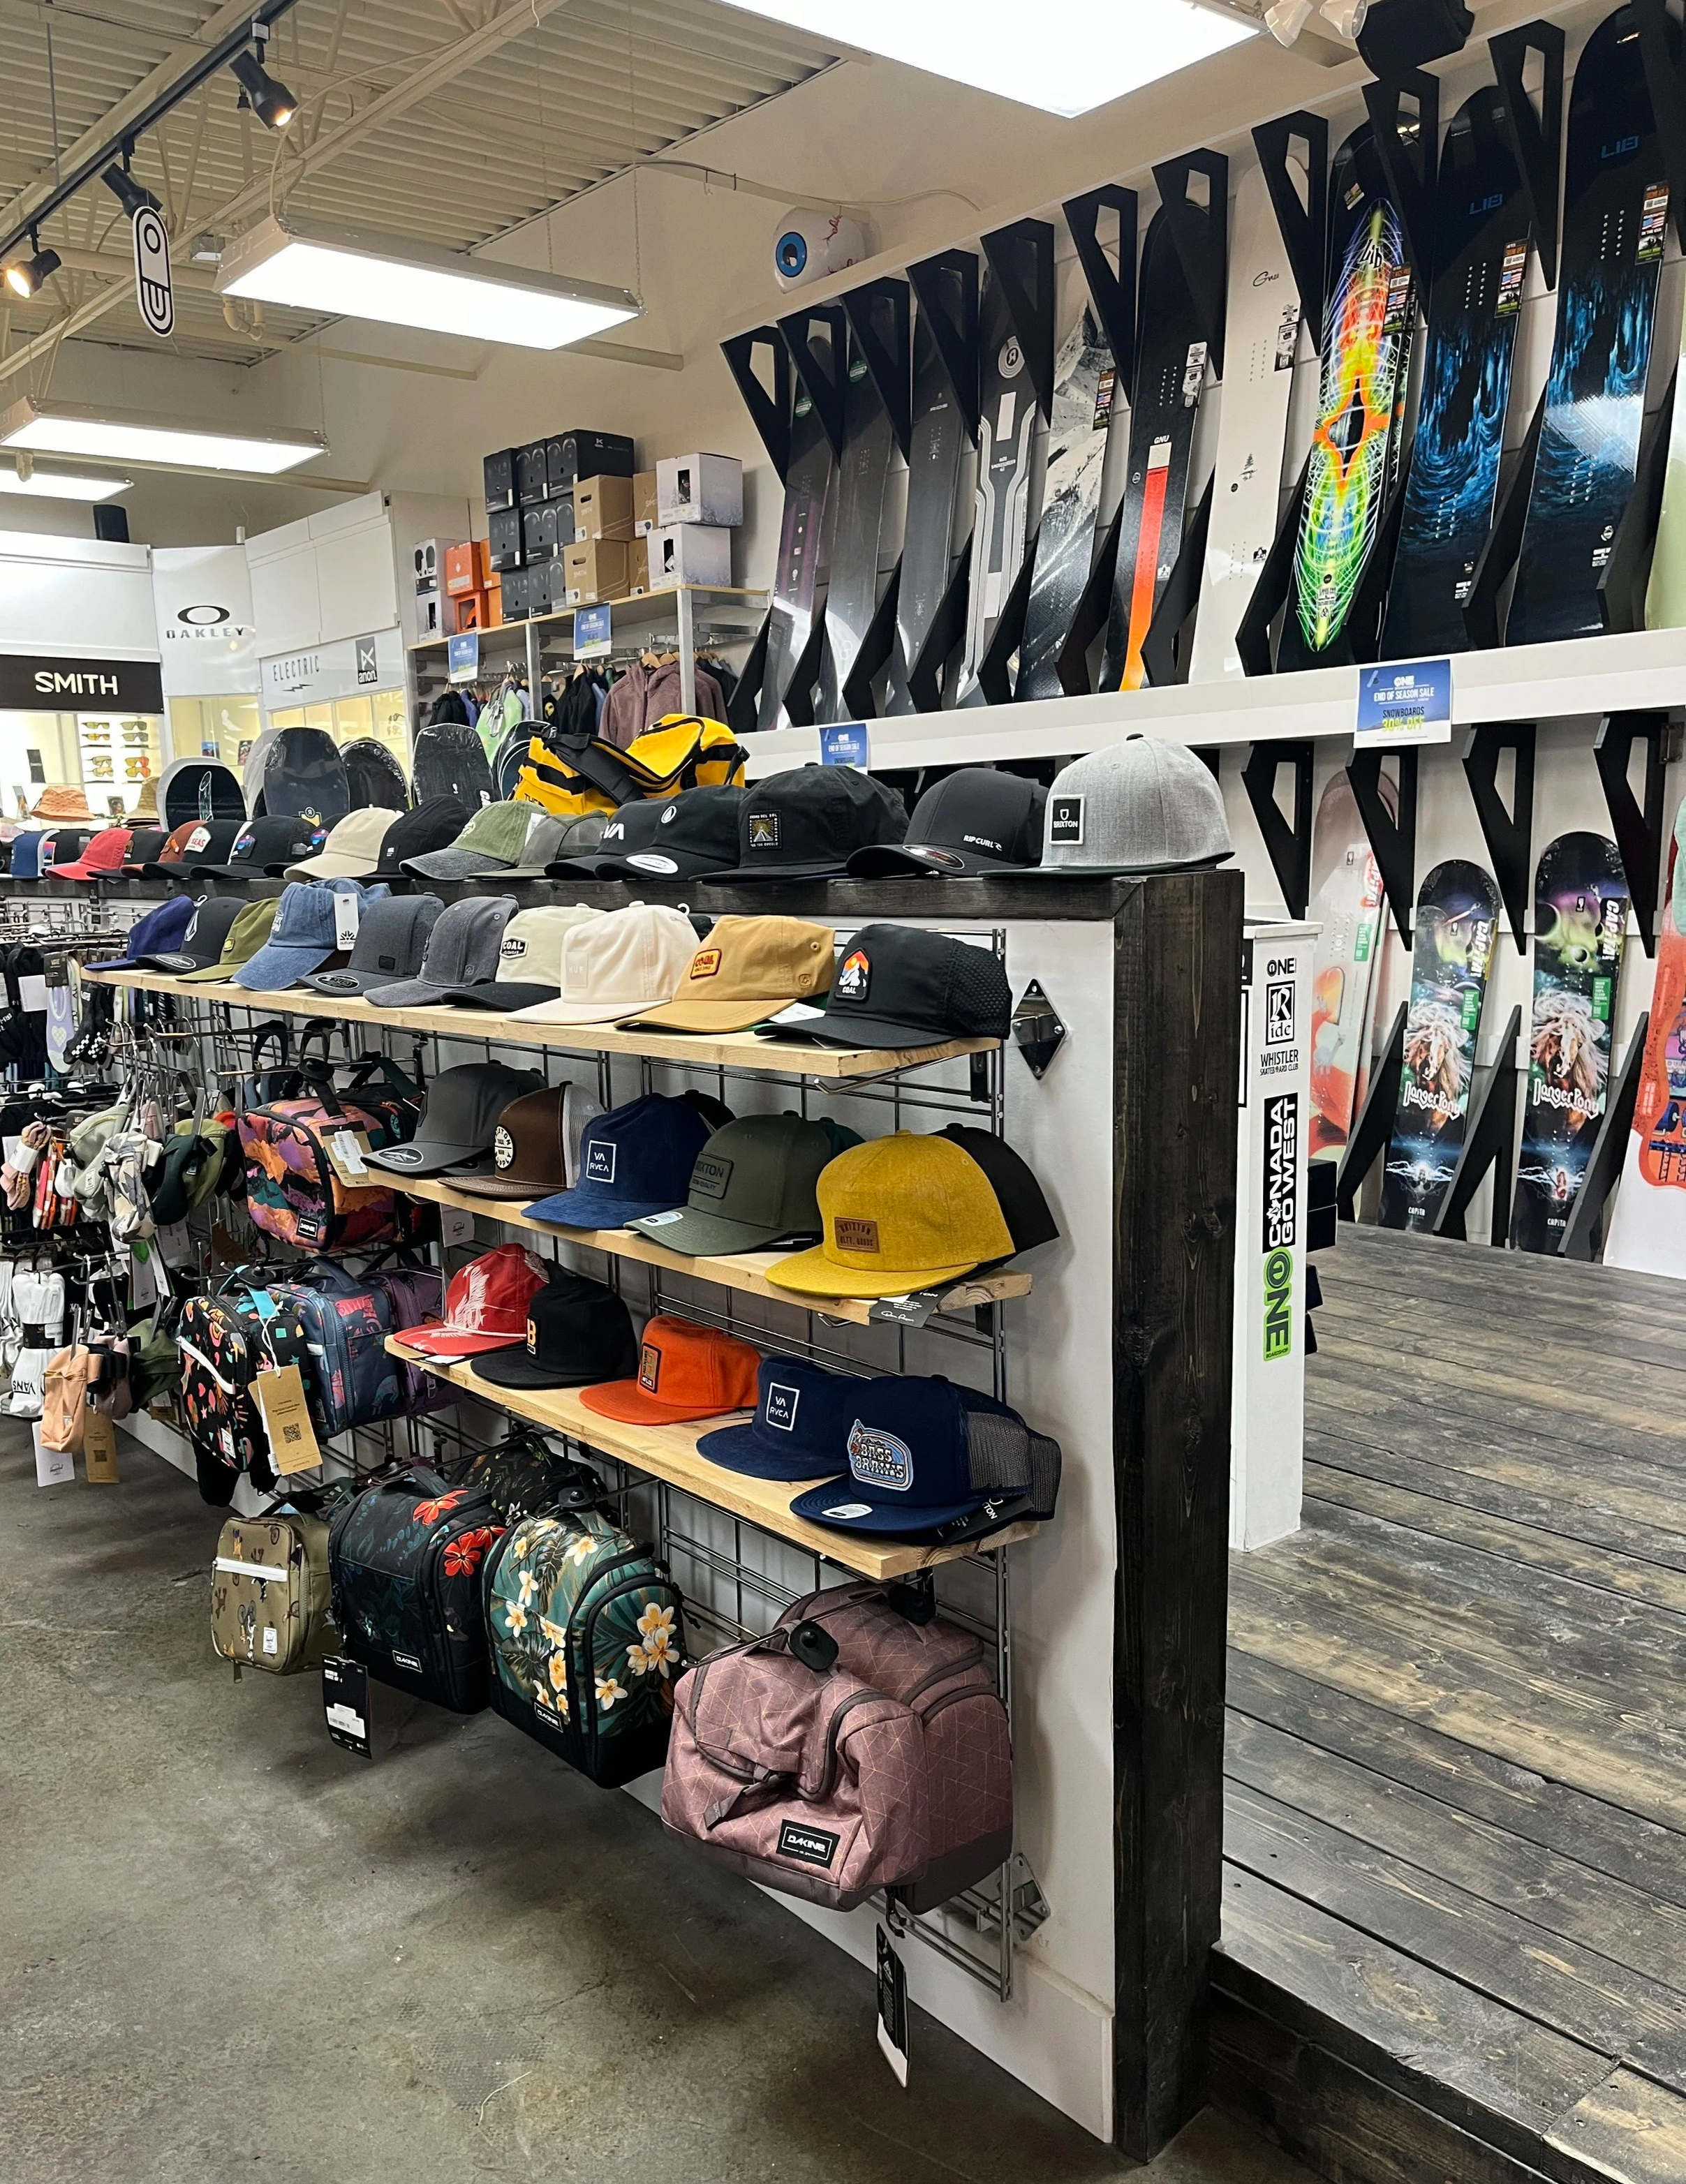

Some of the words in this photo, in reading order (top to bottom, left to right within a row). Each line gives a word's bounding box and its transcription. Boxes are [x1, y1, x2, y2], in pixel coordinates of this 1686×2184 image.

[1601, 135, 1639, 159] LIB
[1469, 193, 1503, 215] LIB
[1153, 435, 1170, 445] GNU
[165, 627, 244, 639] OAKLEY
[273, 655, 320, 682] ELECTRIC
[34, 671, 119, 696] SMITH
[1373, 691, 1386, 702] END
[1386, 690, 1395, 701] OF
[1395, 688, 1419, 700] SEASON
[1419, 687, 1435, 699] SALE
[1382, 706, 1425, 719] SNOWBOARDS
[1407, 716, 1425, 730] OFF
[1053, 820, 1079, 829] BRIXTON
[963, 834, 976, 843] RIP
[975, 838, 994, 849] CURL
[503, 941, 524, 950] COAL
[568, 965, 584, 974] HUF
[1266, 957, 1296, 977] ONE
[841, 986, 857, 995] COAL
[1260, 1048, 1299, 1068] WHISTLER
[1287, 1063, 1299, 1072] CLUB
[1282, 1097, 1296, 1196] WEST
[589, 1162, 609, 1173] RVCA
[1281, 1197, 1294, 1245] GO
[13, 1379, 36, 1395] VANS
[769, 1406, 789, 1419] RVCA
[860, 1443, 893, 1462] BASS
[786, 1834, 826, 1853] DAKINE
